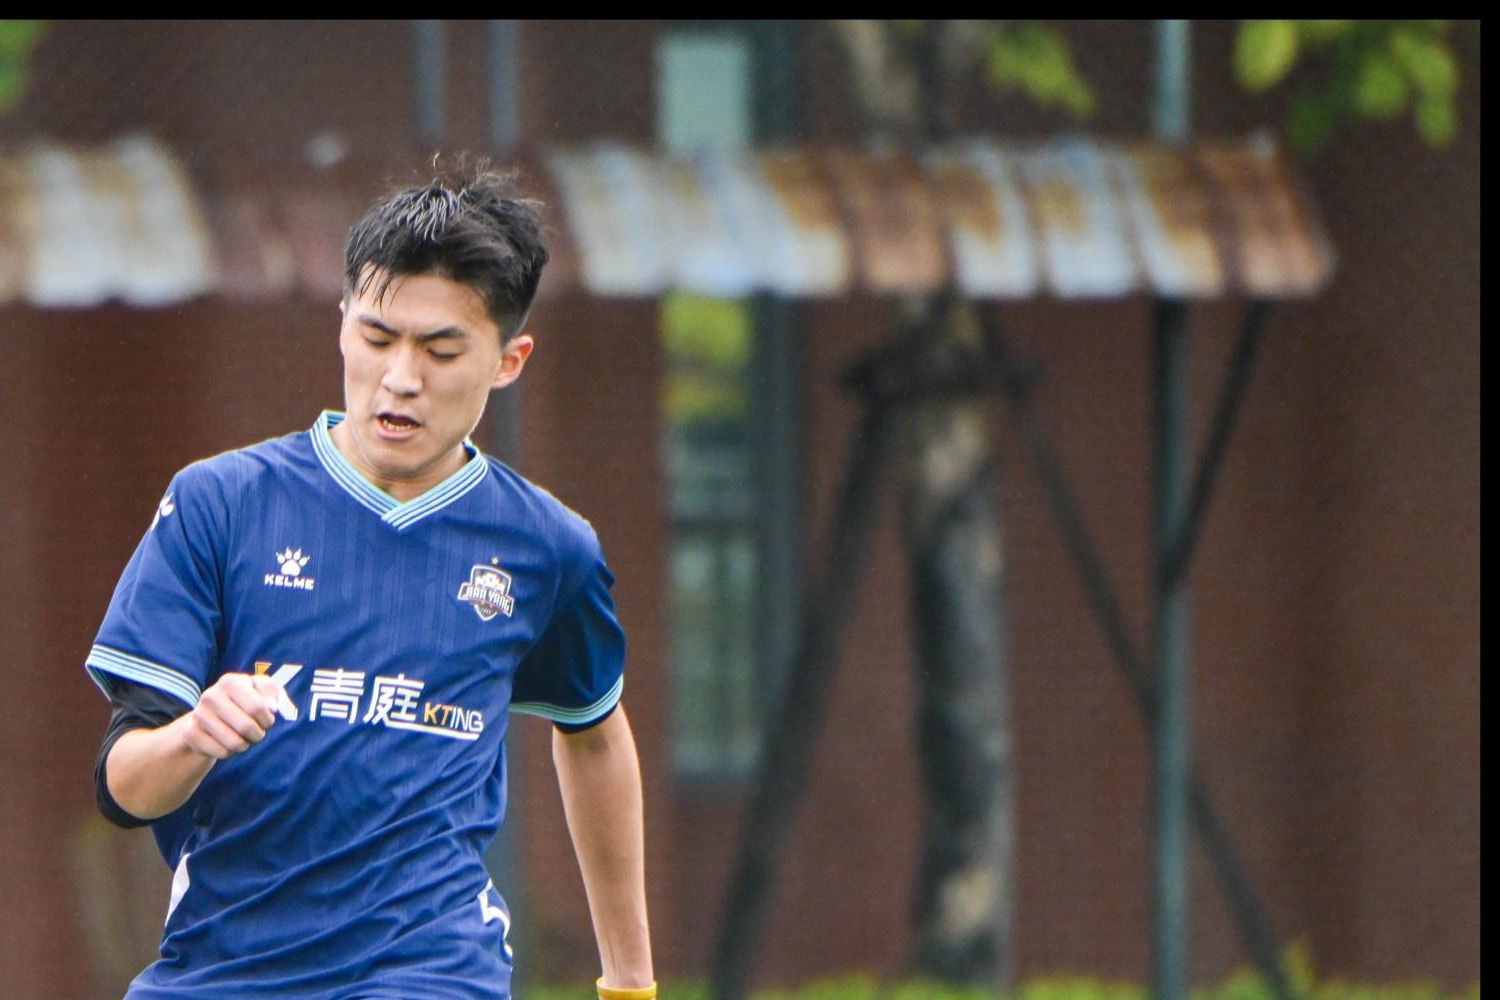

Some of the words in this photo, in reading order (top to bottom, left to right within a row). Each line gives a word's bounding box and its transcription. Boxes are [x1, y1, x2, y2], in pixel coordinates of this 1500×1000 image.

[263, 573, 315, 591] KELME
[308, 668, 425, 728] 青庭
[423, 701, 485, 732] KTING
